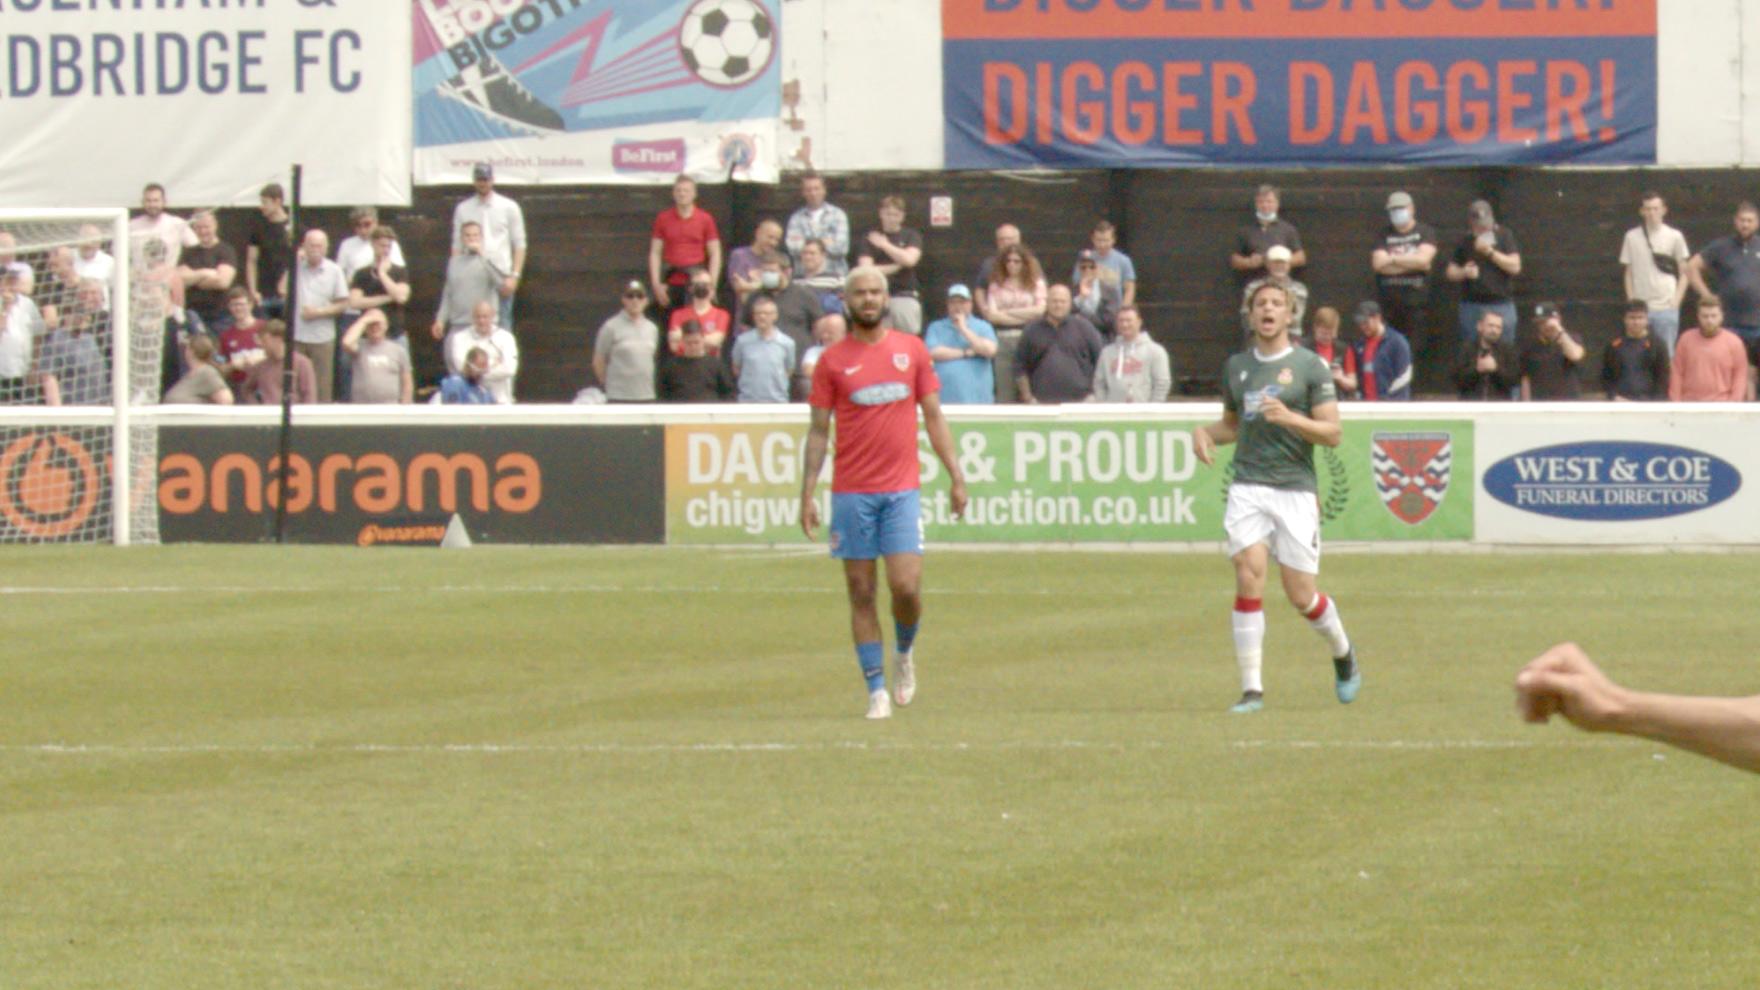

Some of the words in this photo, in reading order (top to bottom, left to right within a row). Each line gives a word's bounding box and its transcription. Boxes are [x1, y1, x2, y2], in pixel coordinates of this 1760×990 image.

[0, 30, 267, 98] DBRIDGE
[294, 29, 361, 94] FC
[982, 61, 1257, 145] DIGGER
[1288, 59, 1616, 146] DAGGER!
[450, 156, 585, 169] wwwbefirst.london
[107, 452, 542, 514] anarama
[687, 431, 939, 484] DAGS
[958, 431, 996, 483] &
[1014, 430, 1197, 483] PROUD
[1514, 457, 1603, 481] WEST
[1609, 458, 1638, 481] &
[1647, 457, 1711, 481] COE
[1516, 487, 1599, 505] FUNERAL
[1603, 486, 1709, 505] DIRECTORS
